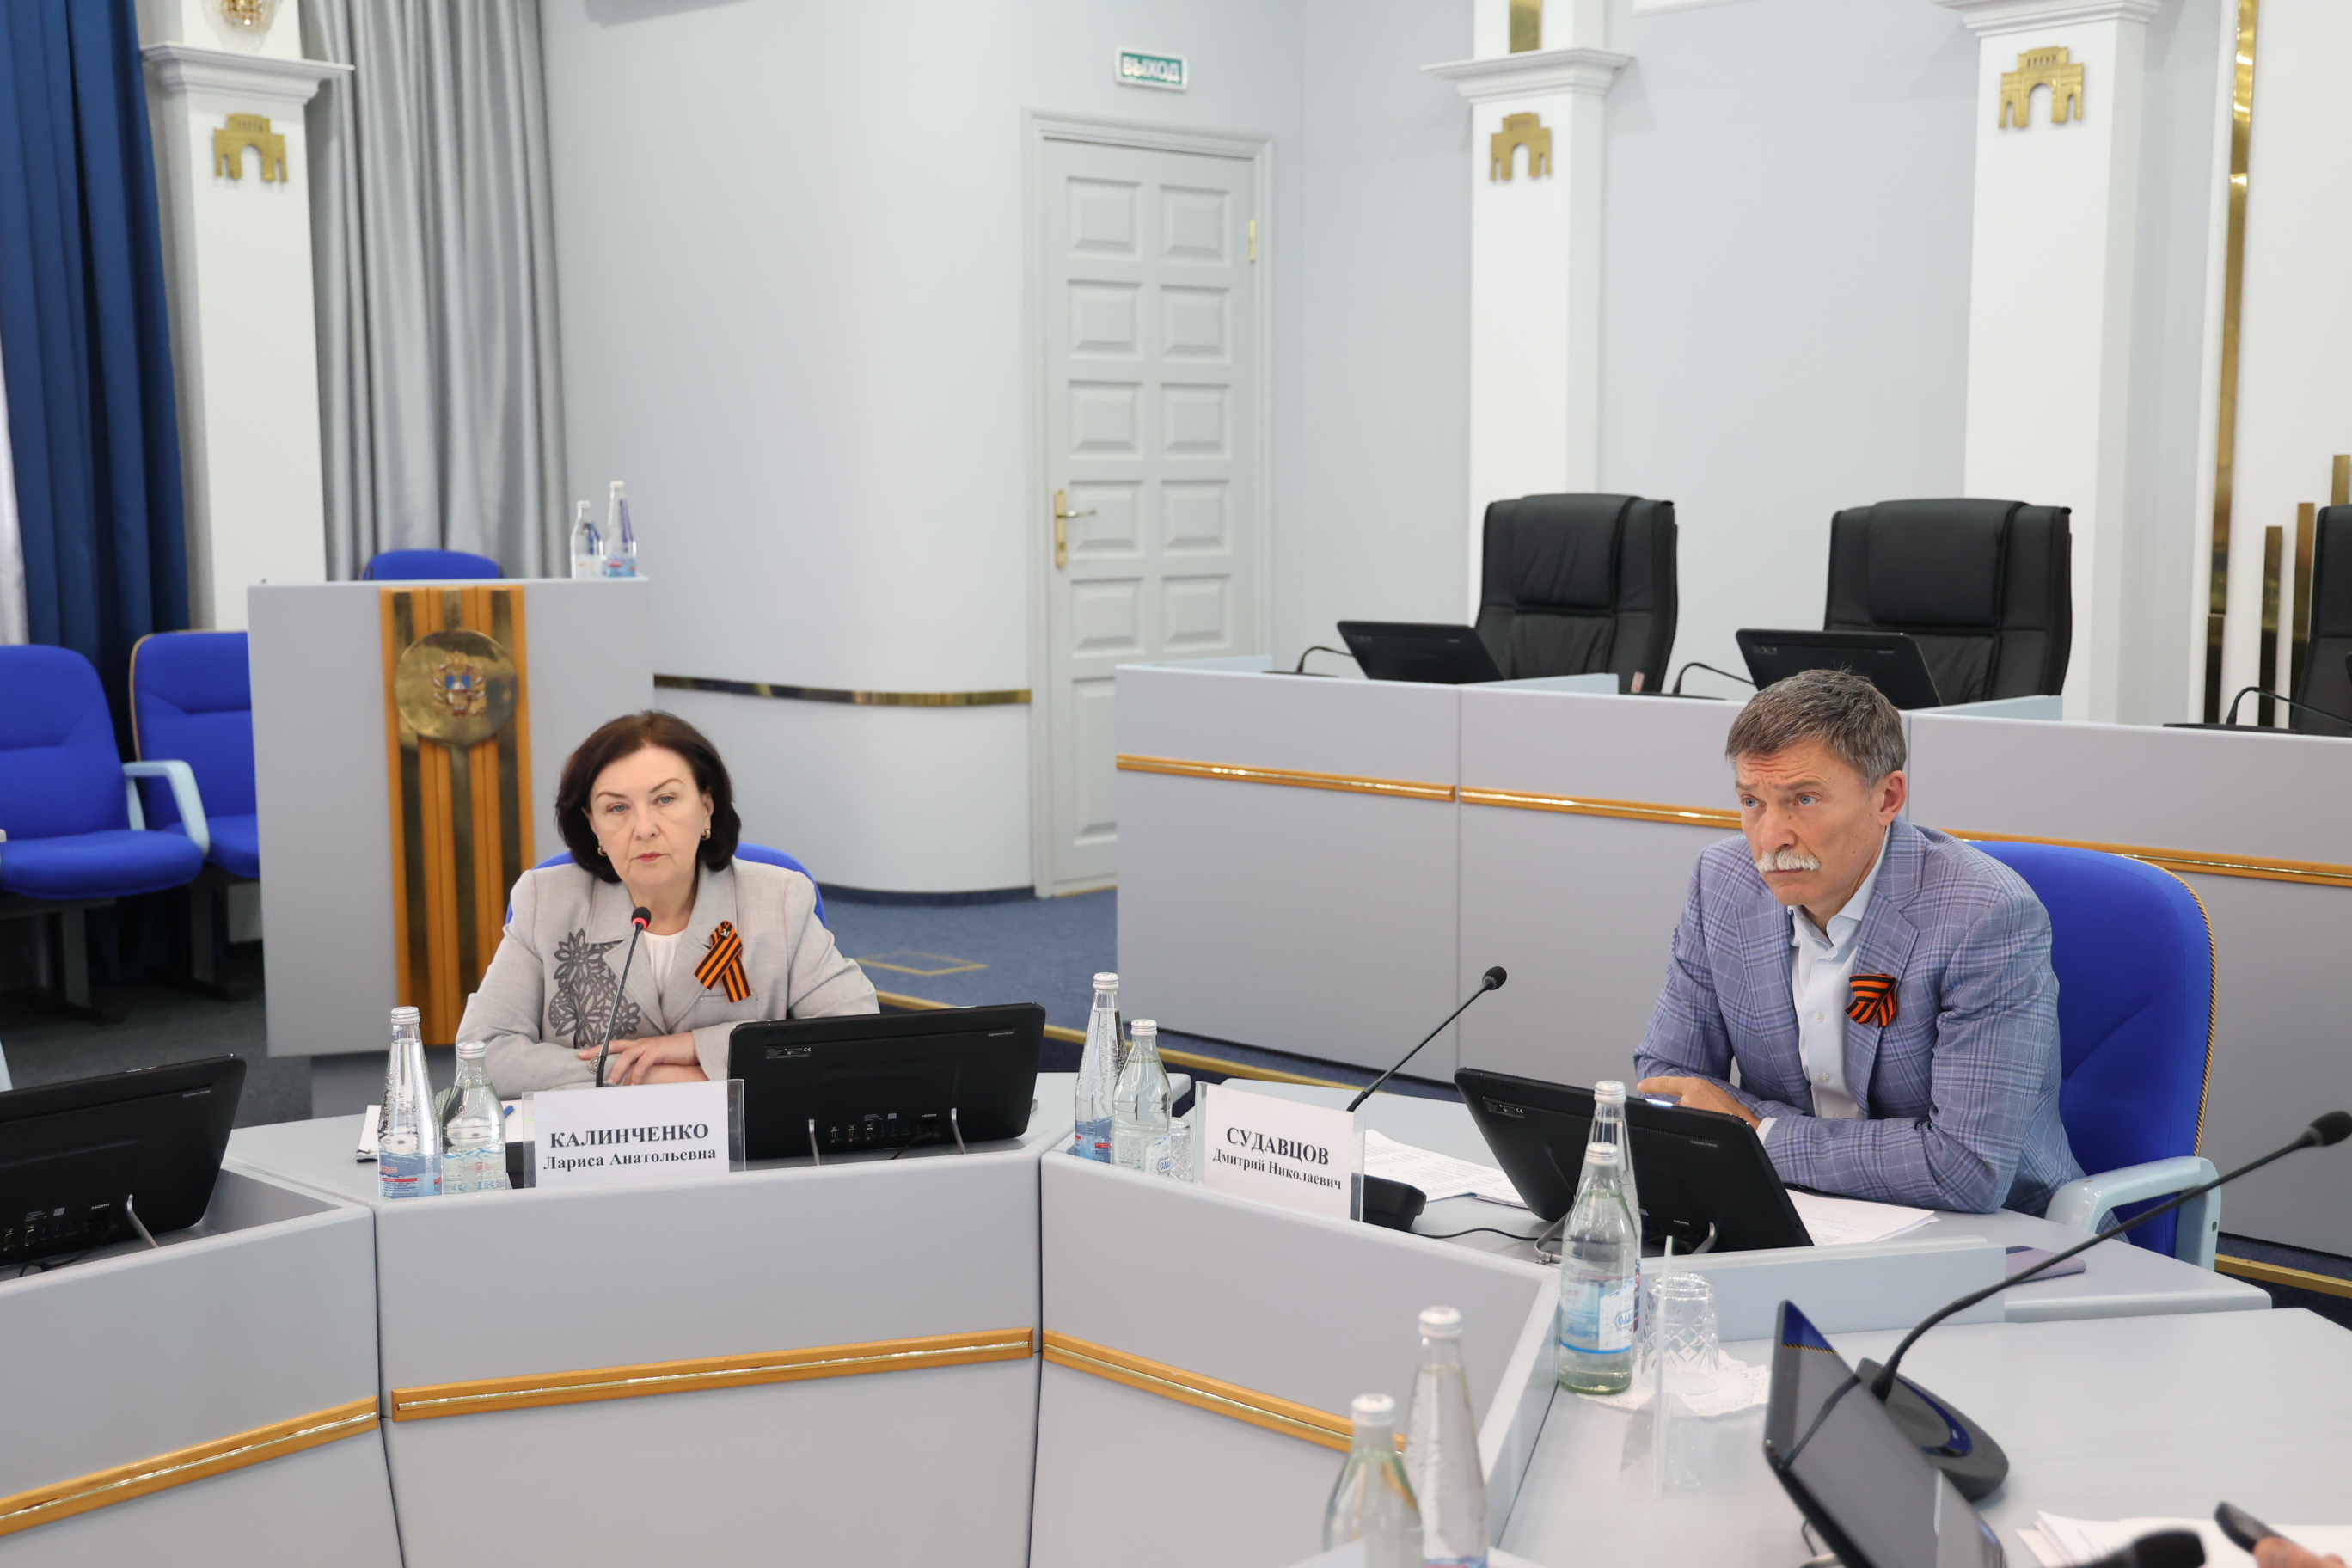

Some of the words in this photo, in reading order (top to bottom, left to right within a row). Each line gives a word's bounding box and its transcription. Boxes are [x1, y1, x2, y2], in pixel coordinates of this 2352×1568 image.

[1122, 55, 1181, 83] ВЫХОД
[549, 1123, 709, 1148] КАЛИНЧЕНКО
[1226, 1126, 1329, 1166] СУДАВЦОВ
[543, 1155, 604, 1172] Лариса
[609, 1148, 716, 1166] Анатольевна
[1212, 1148, 1265, 1172] Дмитрий
[1268, 1161, 1342, 1190] Николаевич
